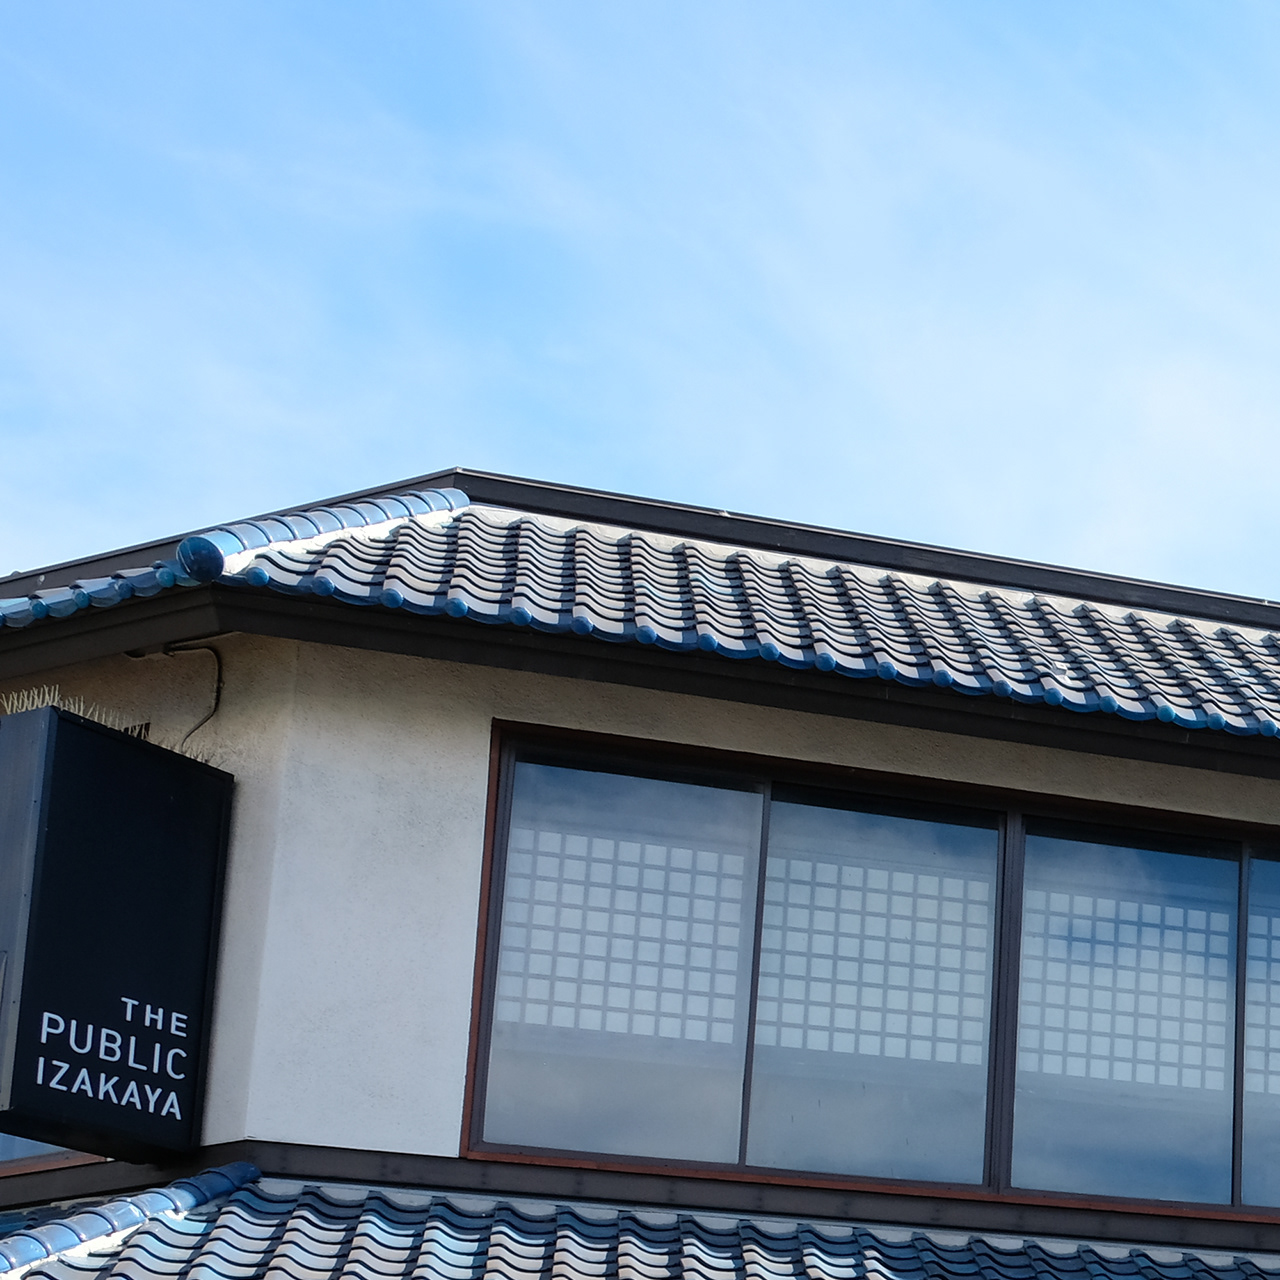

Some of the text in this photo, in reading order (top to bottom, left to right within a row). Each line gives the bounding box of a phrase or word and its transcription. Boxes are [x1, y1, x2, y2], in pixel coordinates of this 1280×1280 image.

[40, 1011, 188, 1080] PUBLIC
[121, 997, 188, 1038] THE
[36, 1056, 182, 1121] IZAKAYA
